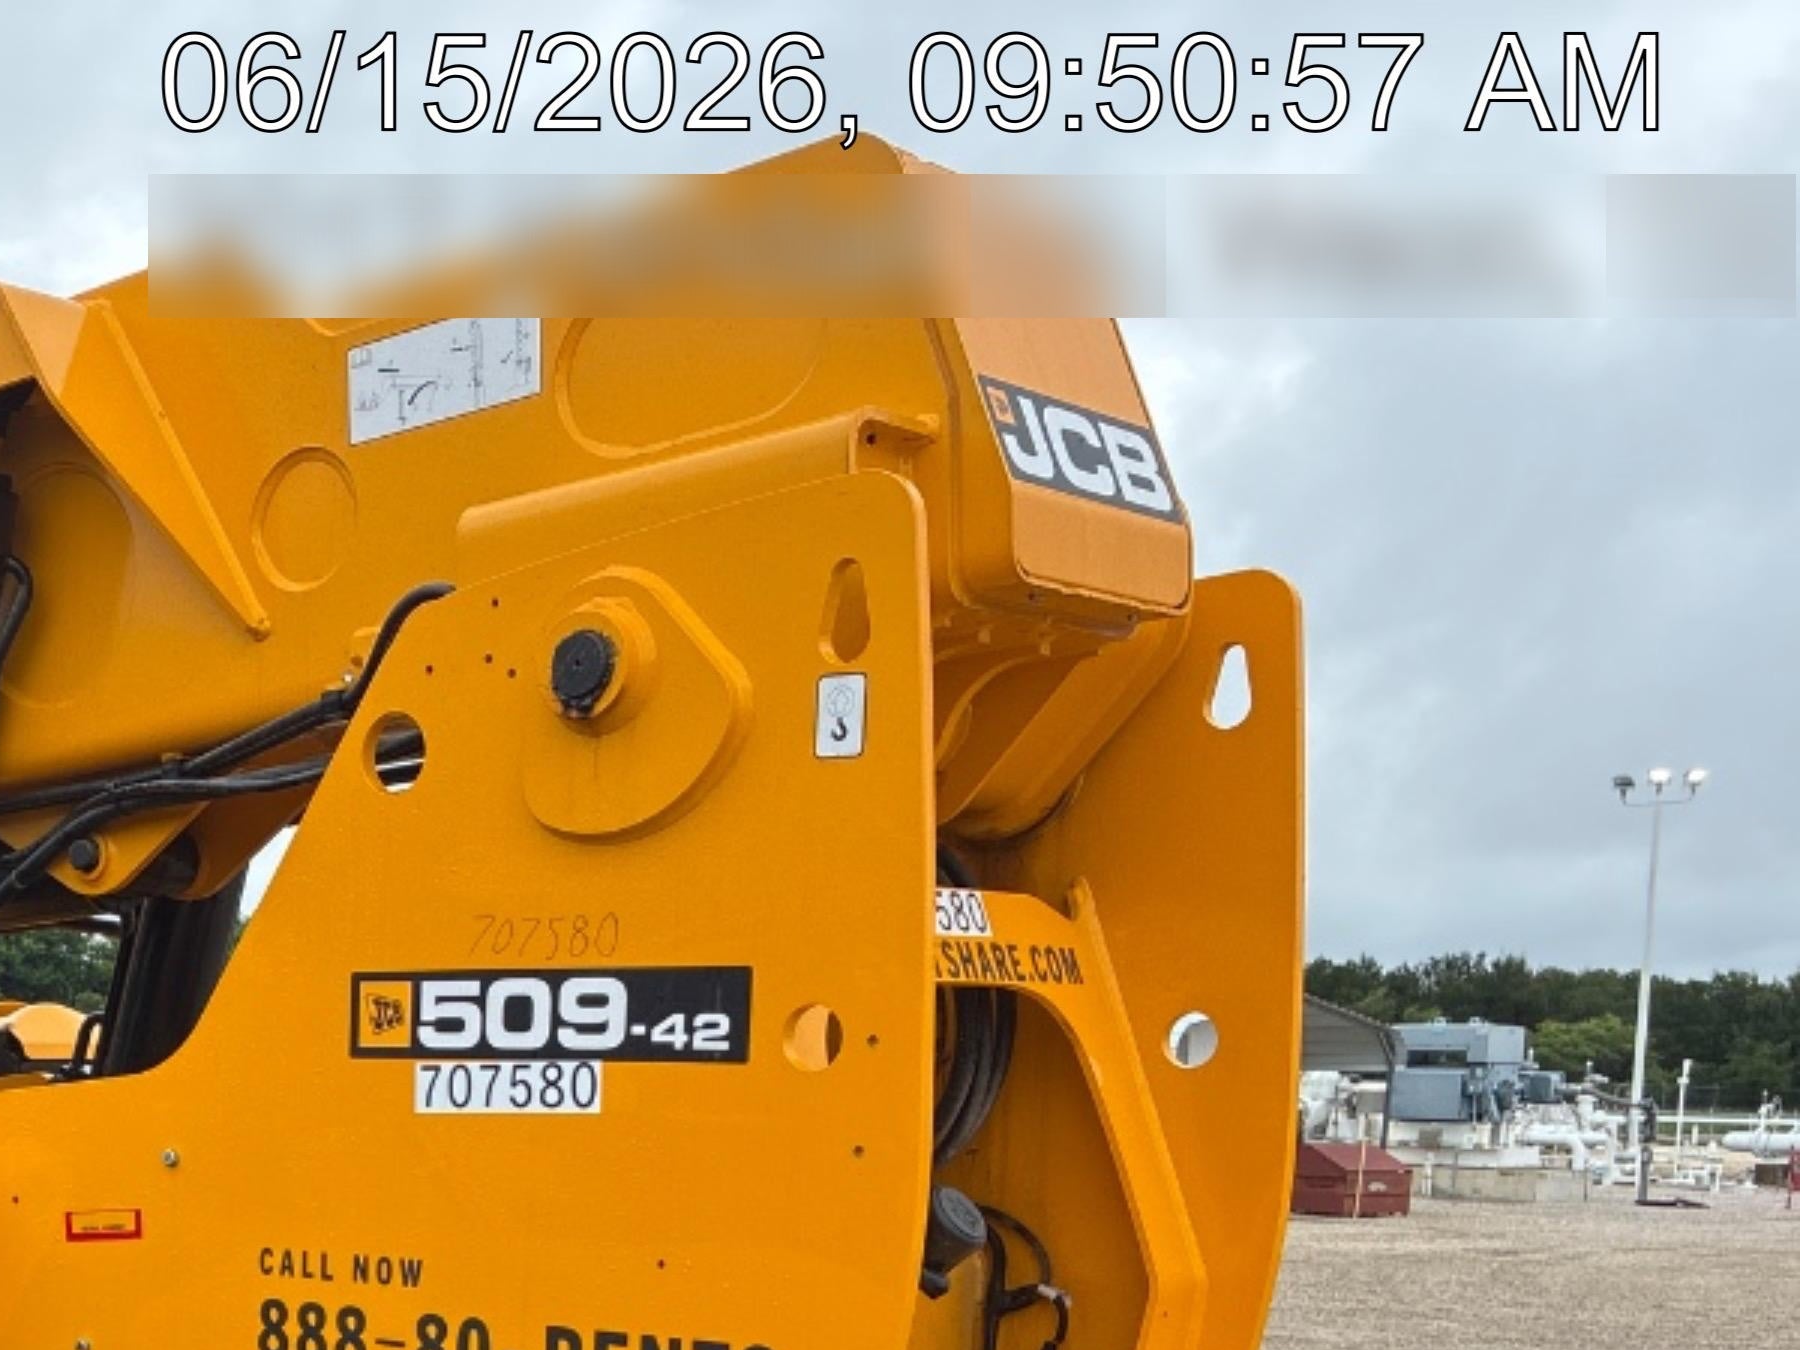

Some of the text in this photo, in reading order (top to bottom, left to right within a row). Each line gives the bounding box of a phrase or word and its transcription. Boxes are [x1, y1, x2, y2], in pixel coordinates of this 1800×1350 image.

[1002, 395, 1173, 512] JCB
[469, 912, 620, 960] 707580
[936, 940, 1083, 984] SHARE.COM
[417, 977, 731, 1051] 509-42
[419, 1061, 598, 1108] 707580
[259, 1247, 423, 1288] CALL NOW
